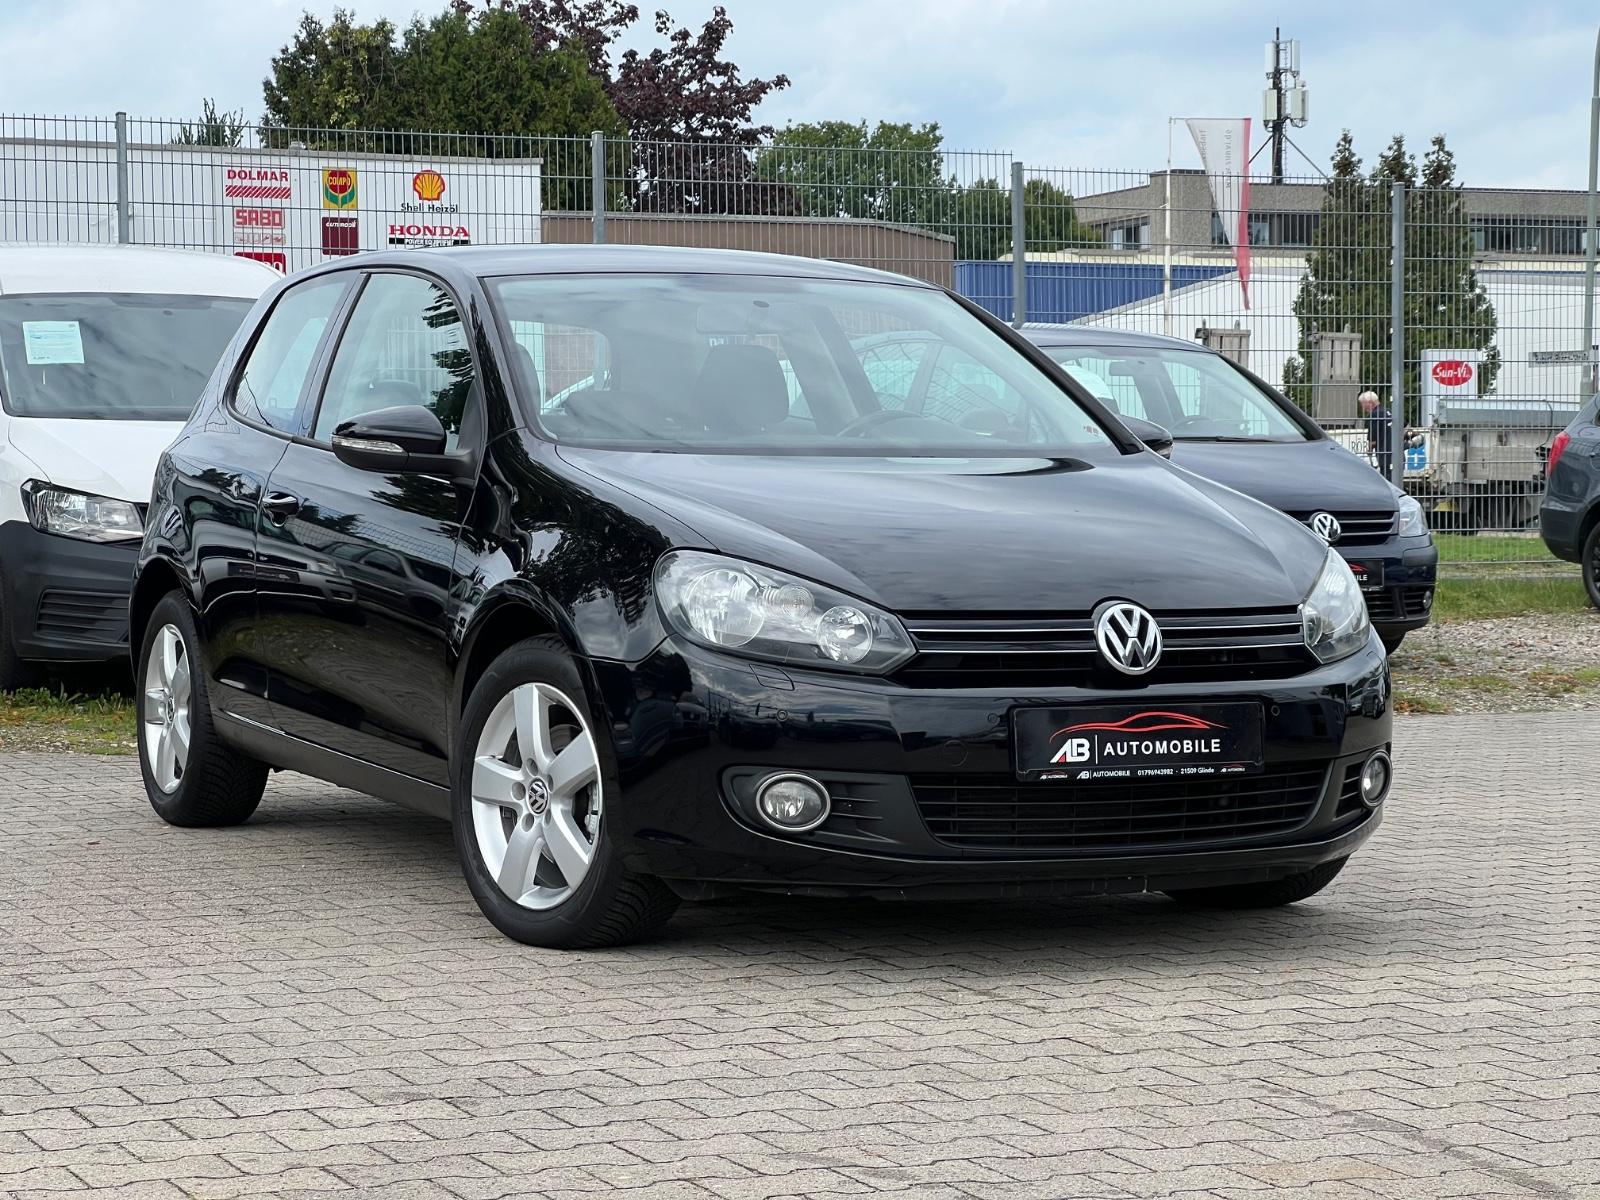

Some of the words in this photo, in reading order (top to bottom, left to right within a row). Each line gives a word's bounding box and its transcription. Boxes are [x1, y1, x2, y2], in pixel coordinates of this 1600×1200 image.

[227, 169, 289, 181] DOLMAR
[328, 176, 351, 186] COMPO
[400, 202, 425, 213] Shell
[428, 204, 459, 214] Heizöl
[236, 209, 282, 226] SABO
[388, 225, 470, 237] HONDA
[1097, 604, 1161, 673] VW
[1104, 739, 1221, 756] AUTOMOBILE
[1092, 770, 1131, 778] AUTOMOBILE
